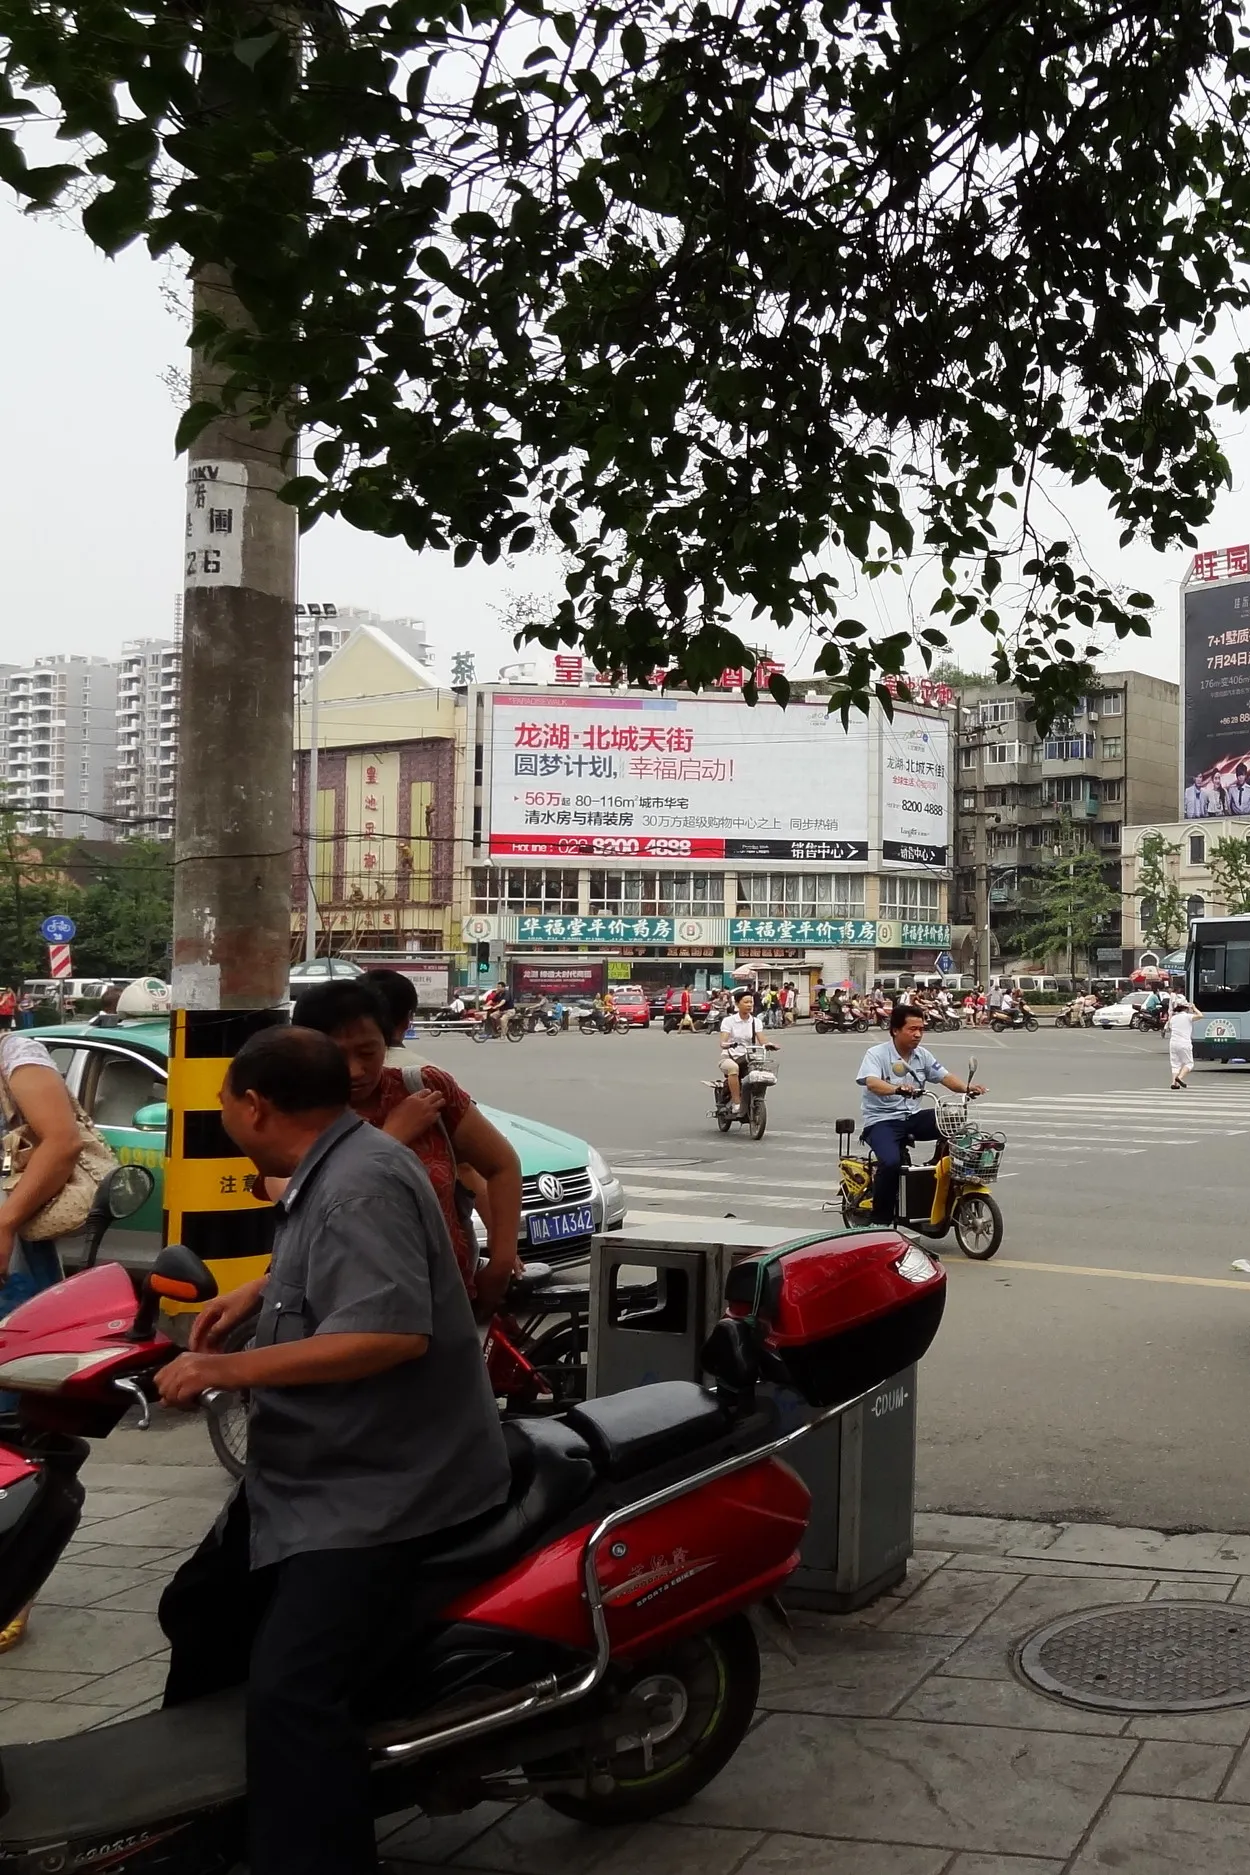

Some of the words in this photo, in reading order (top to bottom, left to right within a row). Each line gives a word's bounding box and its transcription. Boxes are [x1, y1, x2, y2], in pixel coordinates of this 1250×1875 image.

[514, 722, 694, 753] 龙湖·北城天街
[902, 799, 922, 813] 8200
[924, 803, 943, 816] 4888
[525, 810, 634, 827] 清水房与精装房
[642, 815, 781, 830] 30万方超级购物中心之上
[790, 818, 839, 831] 同步热销
[791, 841, 844, 859] 销售中心
[520, 918, 673, 938] 华福堂平价药房
[733, 920, 876, 939] 华福堂平价药房
[902, 923, 950, 943] 华福堂平价药房
